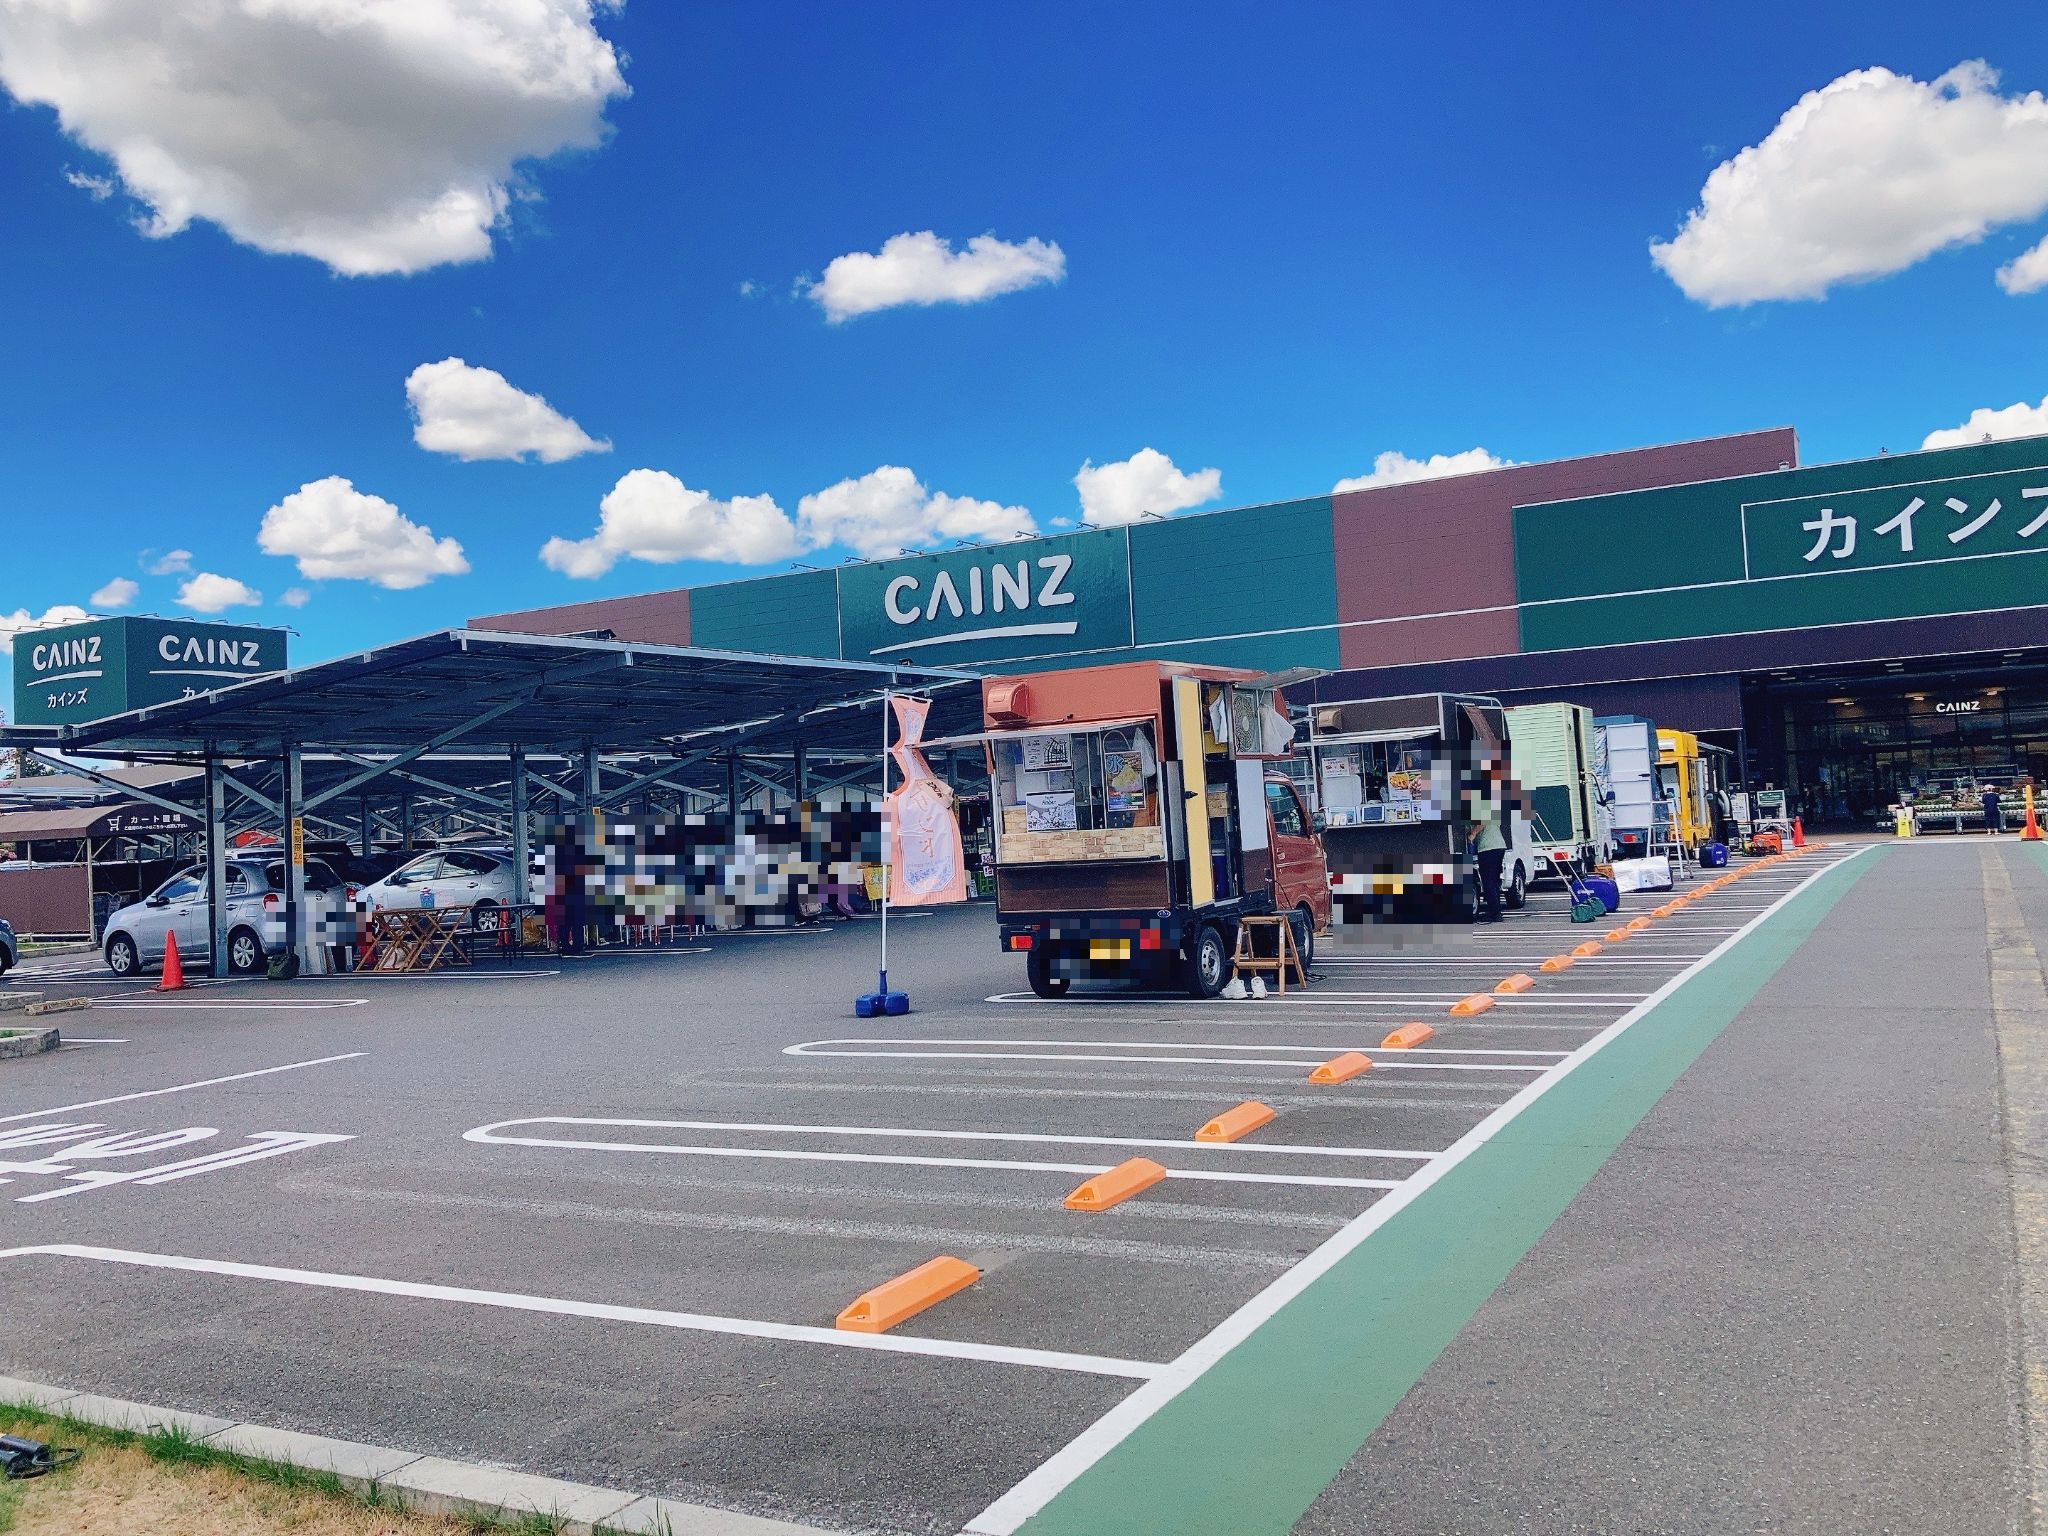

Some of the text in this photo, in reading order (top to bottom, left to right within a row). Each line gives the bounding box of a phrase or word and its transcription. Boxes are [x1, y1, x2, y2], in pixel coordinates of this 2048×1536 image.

[884, 554, 1076, 625] CAINZ
[32, 635, 102, 671] CAINZ
[158, 634, 261, 667] CAINZ
[47, 688, 88, 708] カインズ
[1936, 701, 1981, 713] CAINZ
[1108, 755, 1124, 774] 氷
